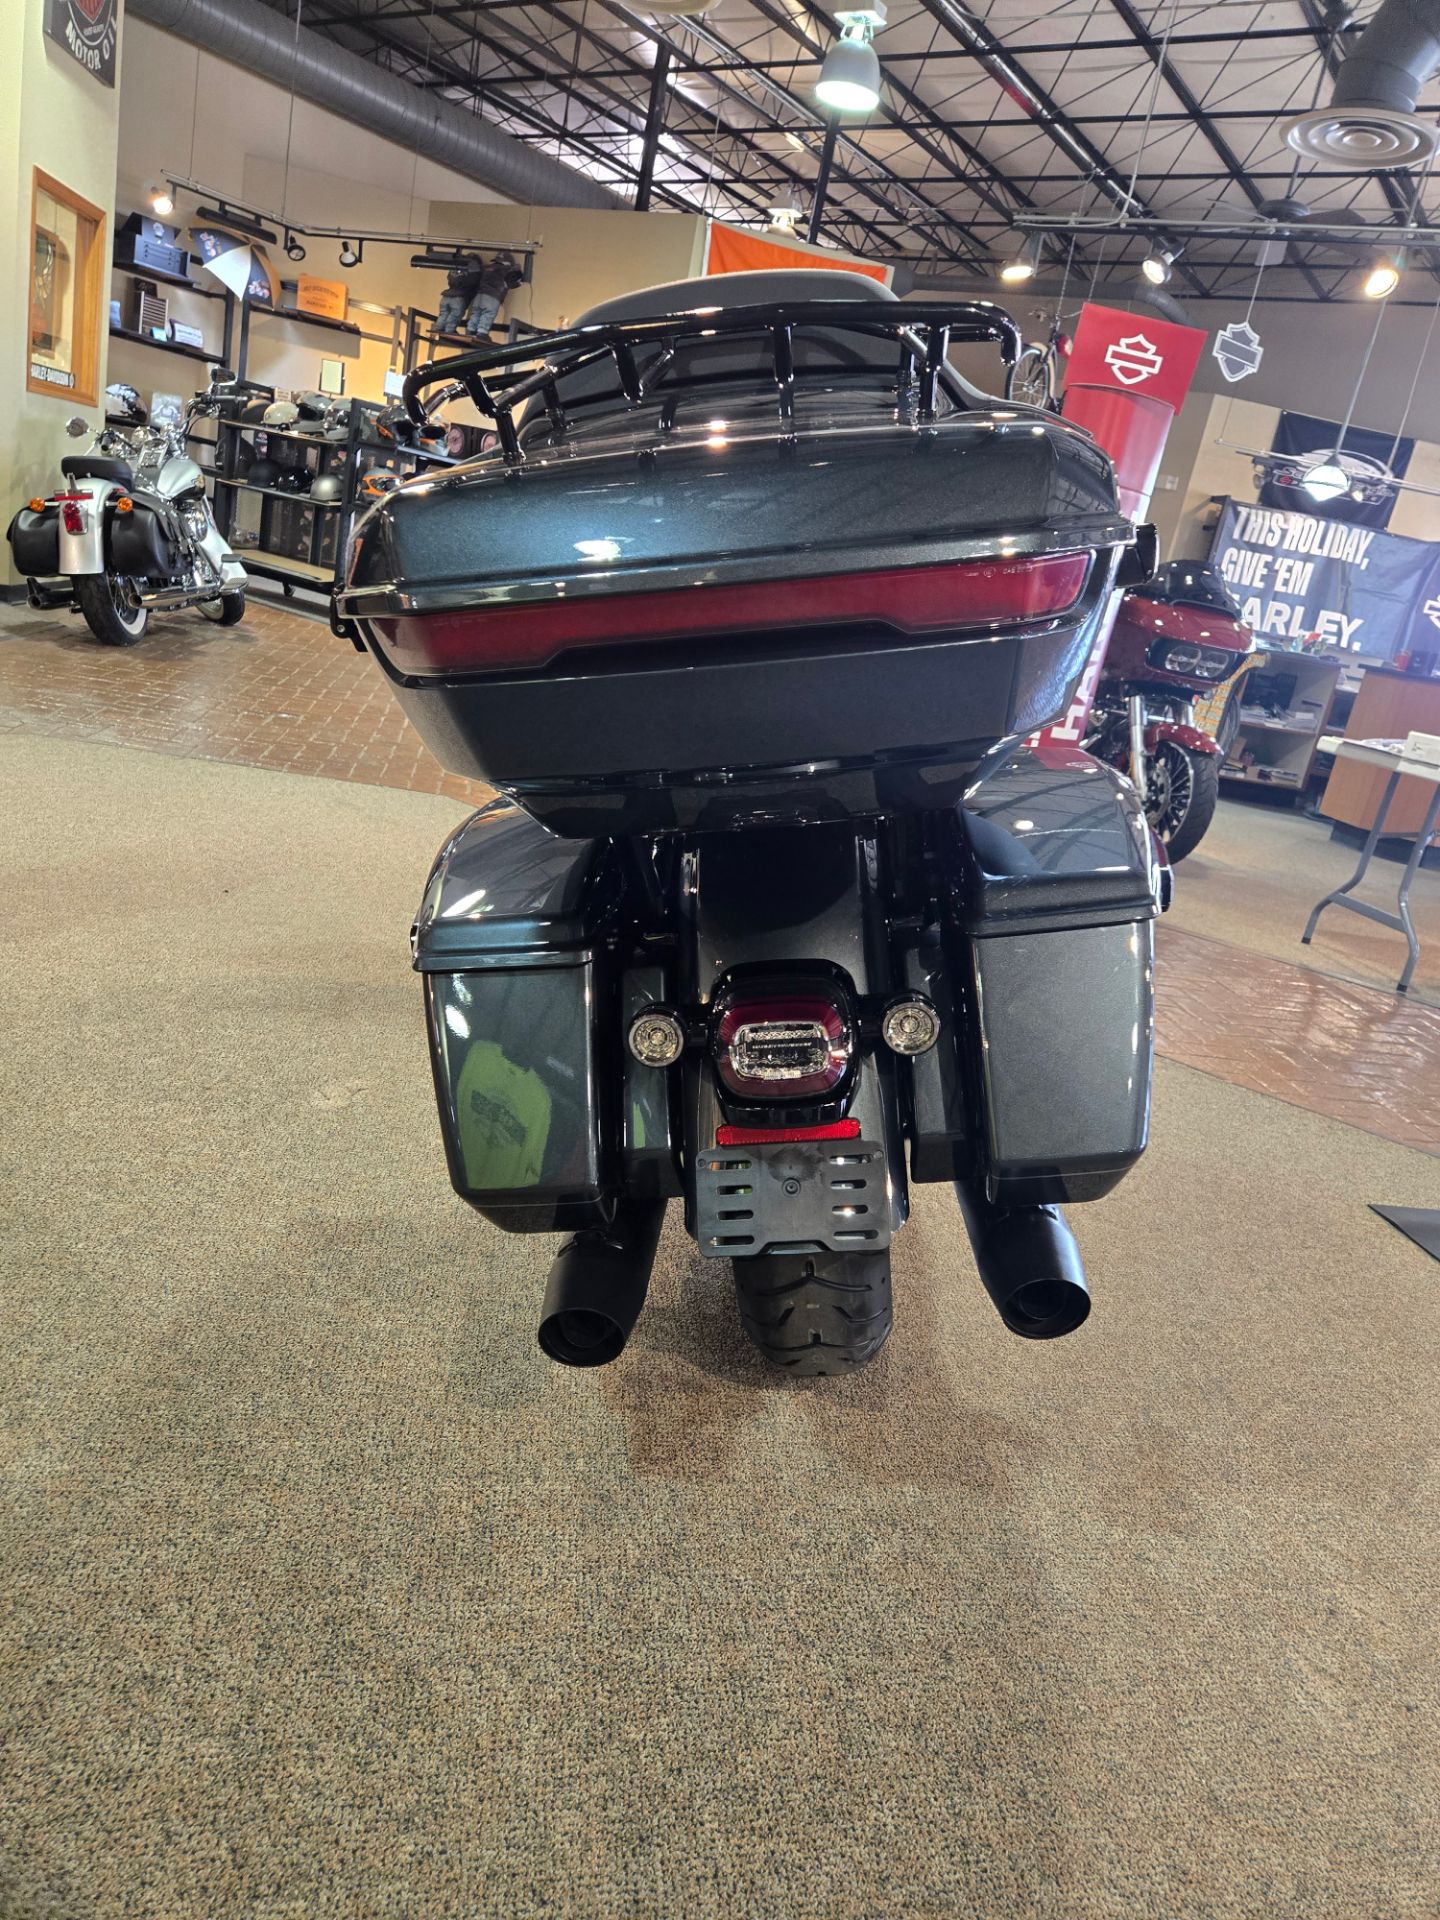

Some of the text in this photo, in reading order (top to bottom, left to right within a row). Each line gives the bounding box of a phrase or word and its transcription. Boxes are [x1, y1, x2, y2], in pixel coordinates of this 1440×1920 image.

[65, 19, 101, 70] MOTOR
[1232, 507, 1375, 570] THIS HOLIDAY,
[1221, 547, 1273, 589] GIVE
[1233, 594, 1364, 651] ARLEY.
